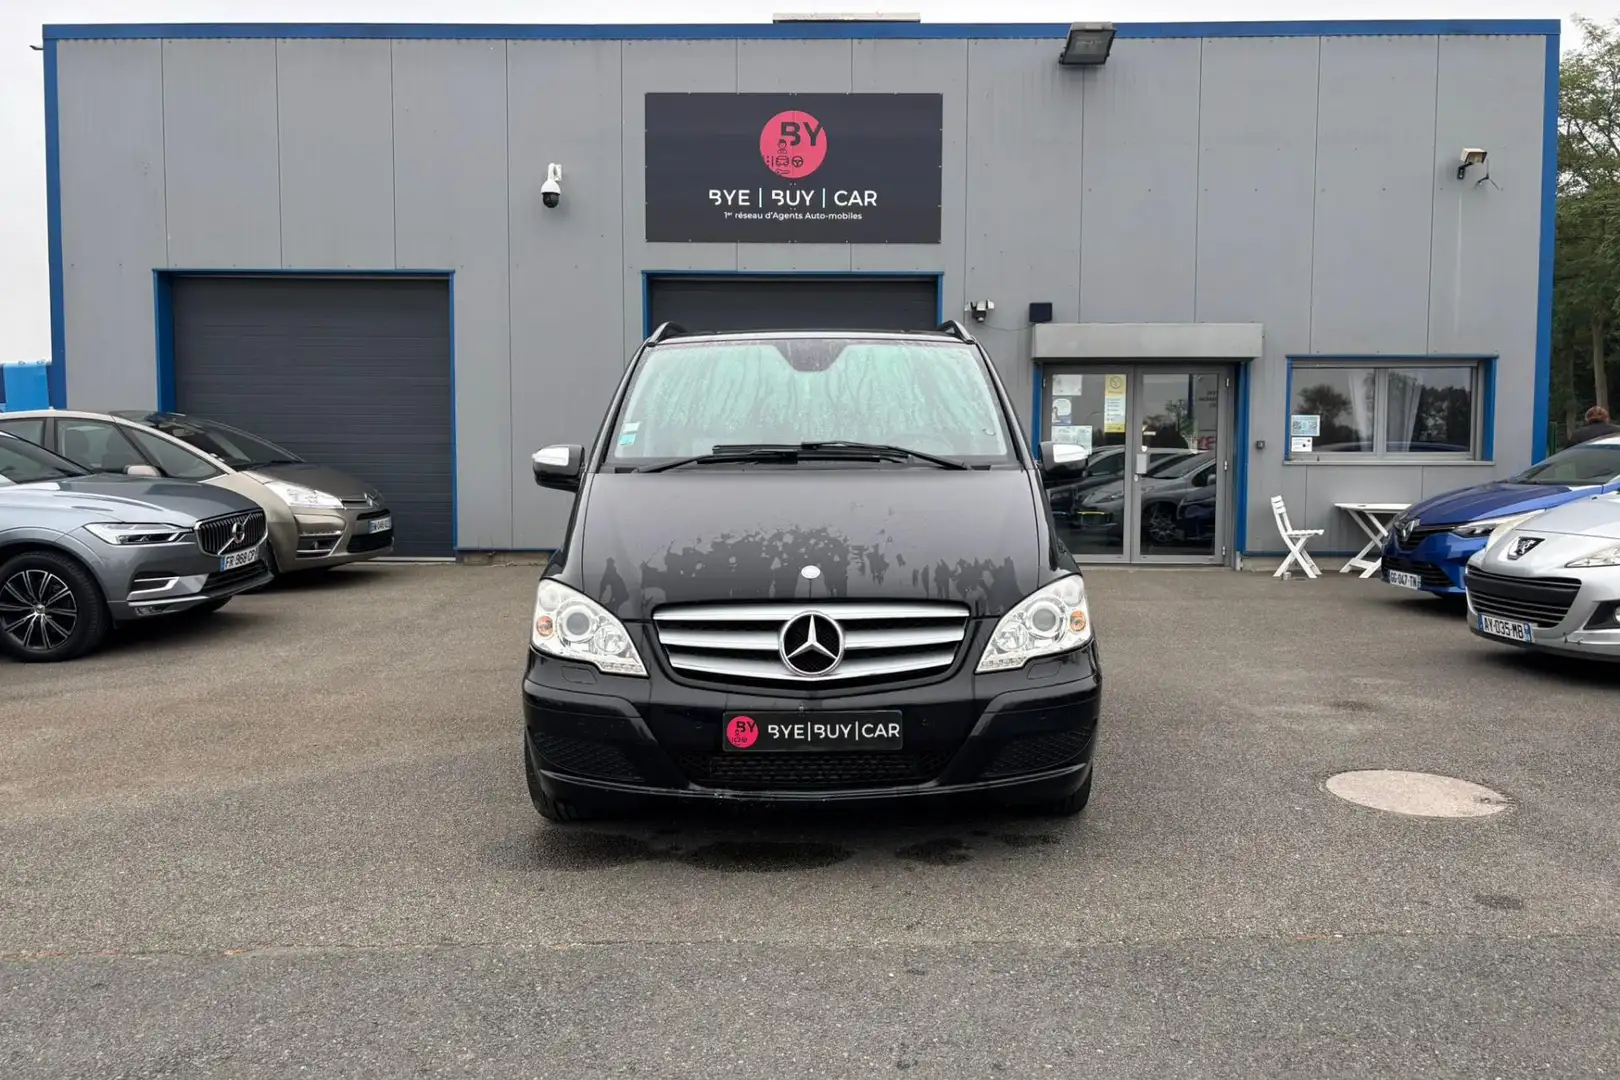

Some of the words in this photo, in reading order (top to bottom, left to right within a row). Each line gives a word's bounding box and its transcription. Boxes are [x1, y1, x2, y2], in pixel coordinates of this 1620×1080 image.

[780, 121, 823, 147] BY
[708, 189, 750, 206] BYE
[771, 189, 815, 206] BUY
[833, 190, 877, 207] CAR
[734, 211, 763, 220] réseau
[804, 211, 863, 220] Auto-mobiles
[1483, 616, 1524, 639] AY-035-MB
[736, 720, 757, 733] BY
[861, 723, 900, 738] CAR
